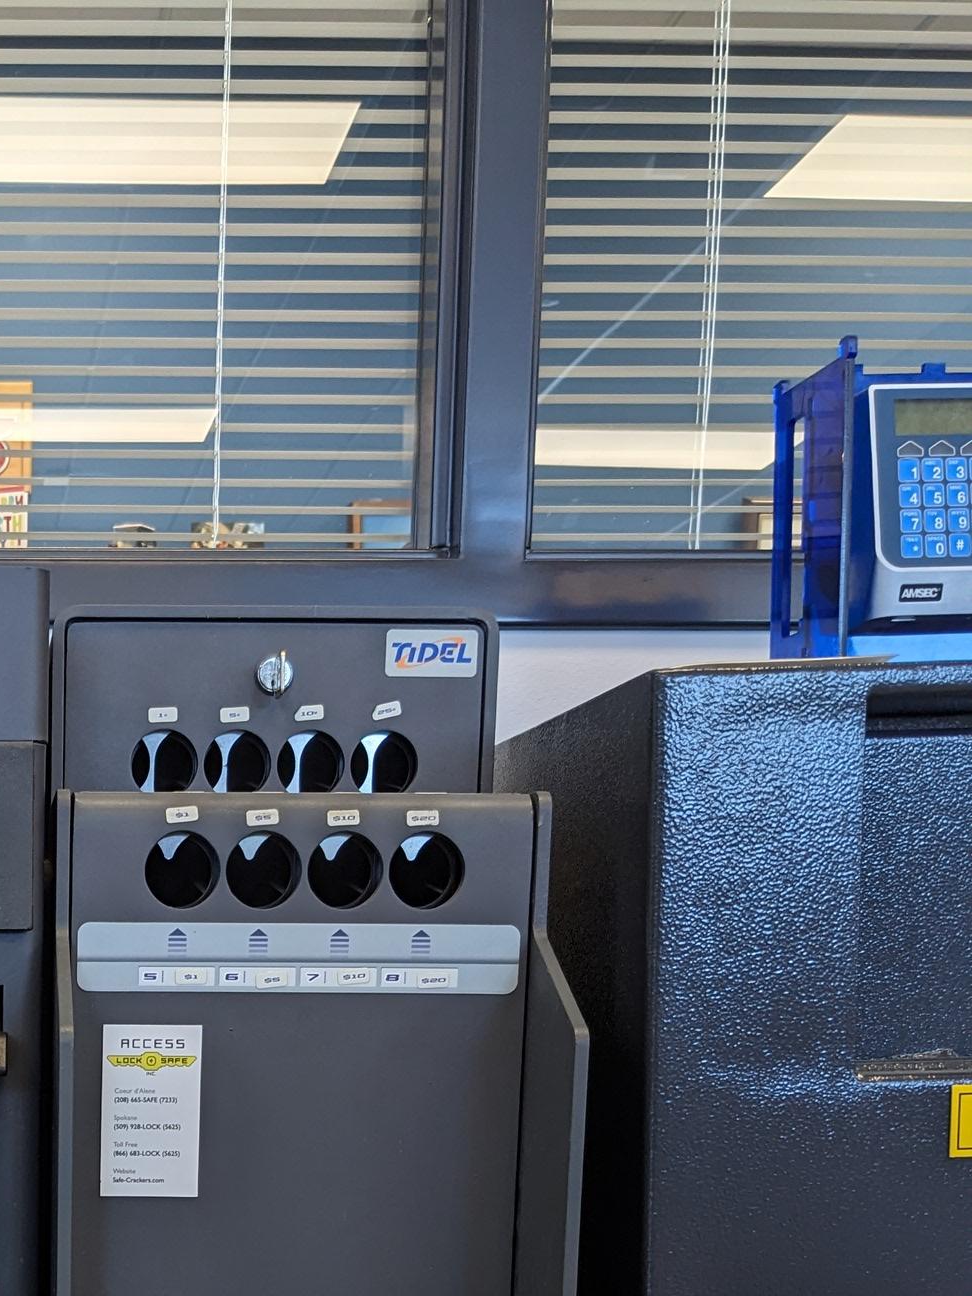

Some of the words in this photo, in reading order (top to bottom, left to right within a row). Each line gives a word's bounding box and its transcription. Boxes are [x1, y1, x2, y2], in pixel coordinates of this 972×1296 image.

[910, 466, 917, 479] 1
[932, 466, 941, 479] 2
[956, 465, 965, 478] 3
[909, 492, 918, 504] 4
[933, 491, 942, 504] 5
[957, 491, 966, 503] 6
[910, 518, 919, 530] 7
[934, 517, 943, 529] 8
[958, 516, 967, 529] 9
[935, 542, 945, 554] 0
[900, 588, 938, 599] AMSEC
[391, 642, 472, 664] TIDEL
[143, 972, 158, 981] 5
[224, 973, 239, 981] 6
[306, 973, 320, 982] 7
[385, 974, 400, 982] 8
[120, 1038, 185, 1049] ACCESS
[113, 1114, 138, 1122] Spokane
